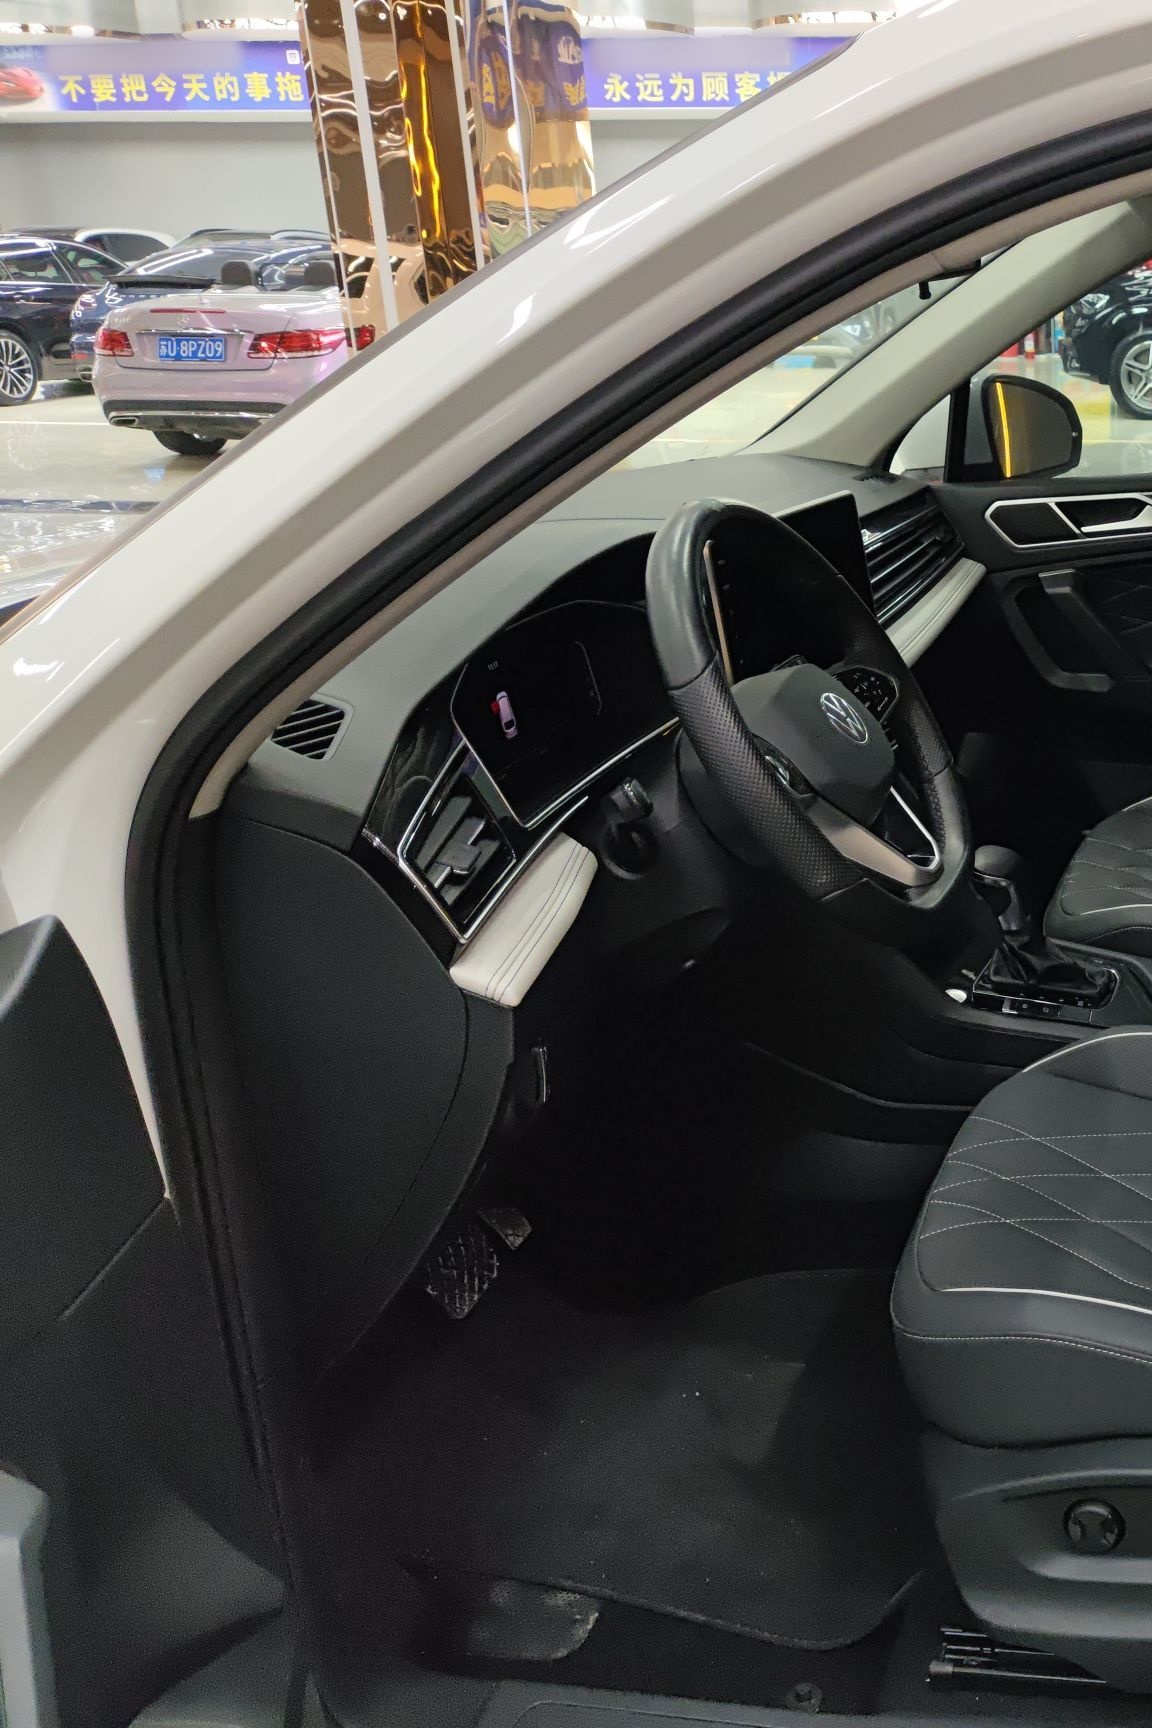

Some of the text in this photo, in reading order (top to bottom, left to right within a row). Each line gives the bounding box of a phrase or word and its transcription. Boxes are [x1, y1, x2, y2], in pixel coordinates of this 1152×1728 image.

[58, 72, 304, 103] 不要把今天的事拖
